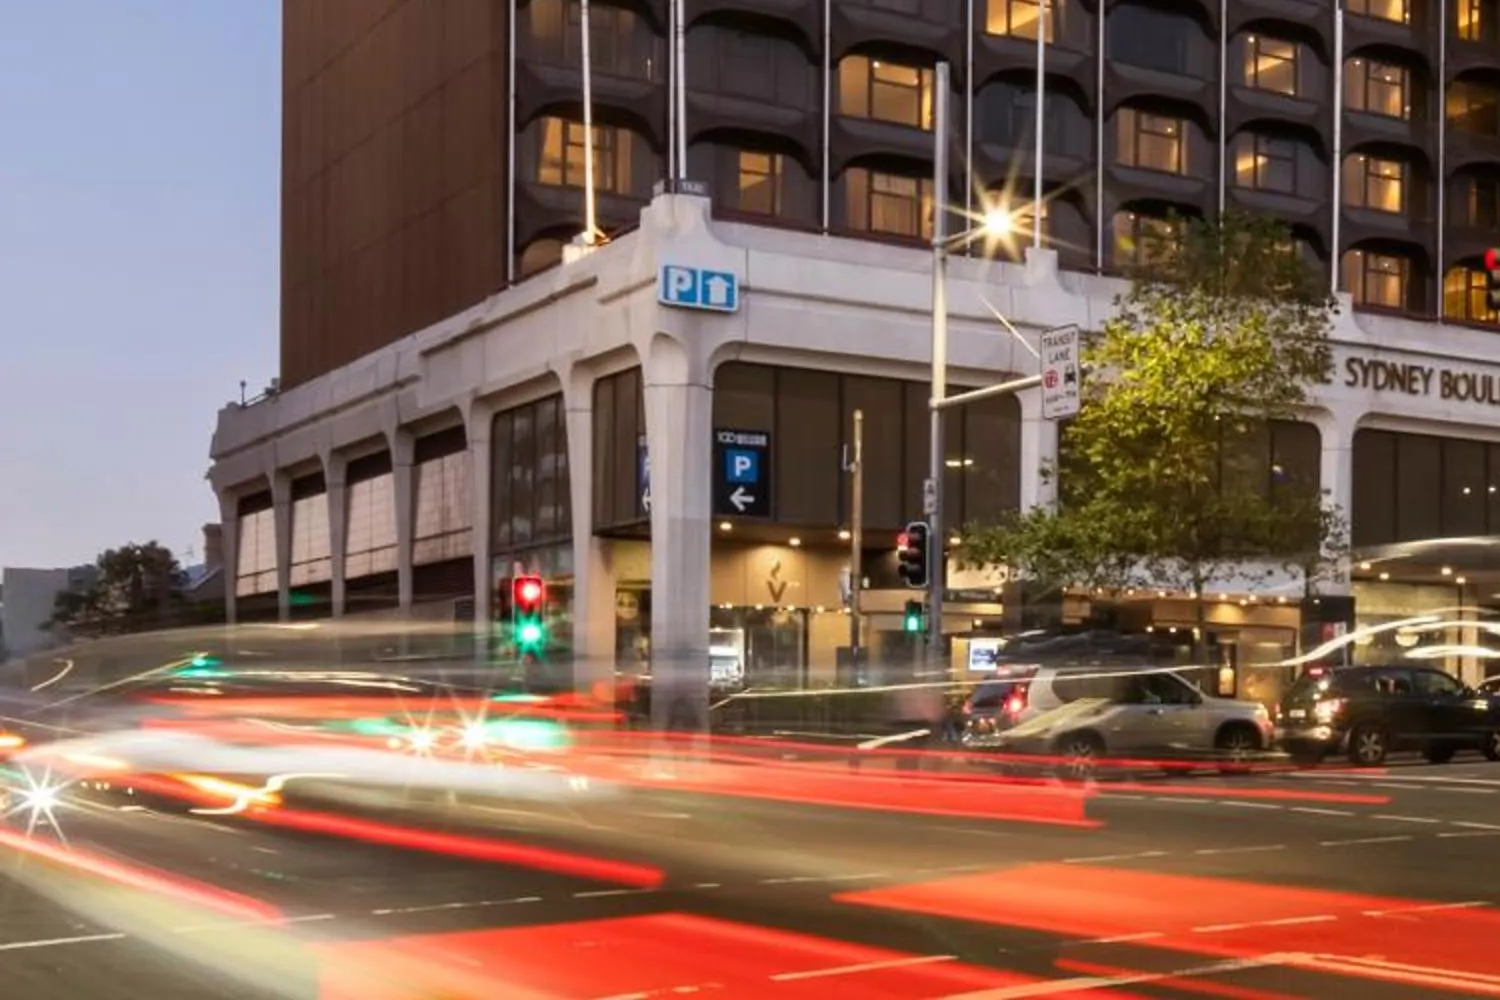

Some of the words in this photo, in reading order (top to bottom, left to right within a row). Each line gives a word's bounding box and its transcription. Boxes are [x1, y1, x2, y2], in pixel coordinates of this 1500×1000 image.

[668, 267, 693, 301] P
[1048, 347, 1071, 364] LANE
[1345, 356, 1433, 396] SYDNEY
[735, 455, 752, 477] P
